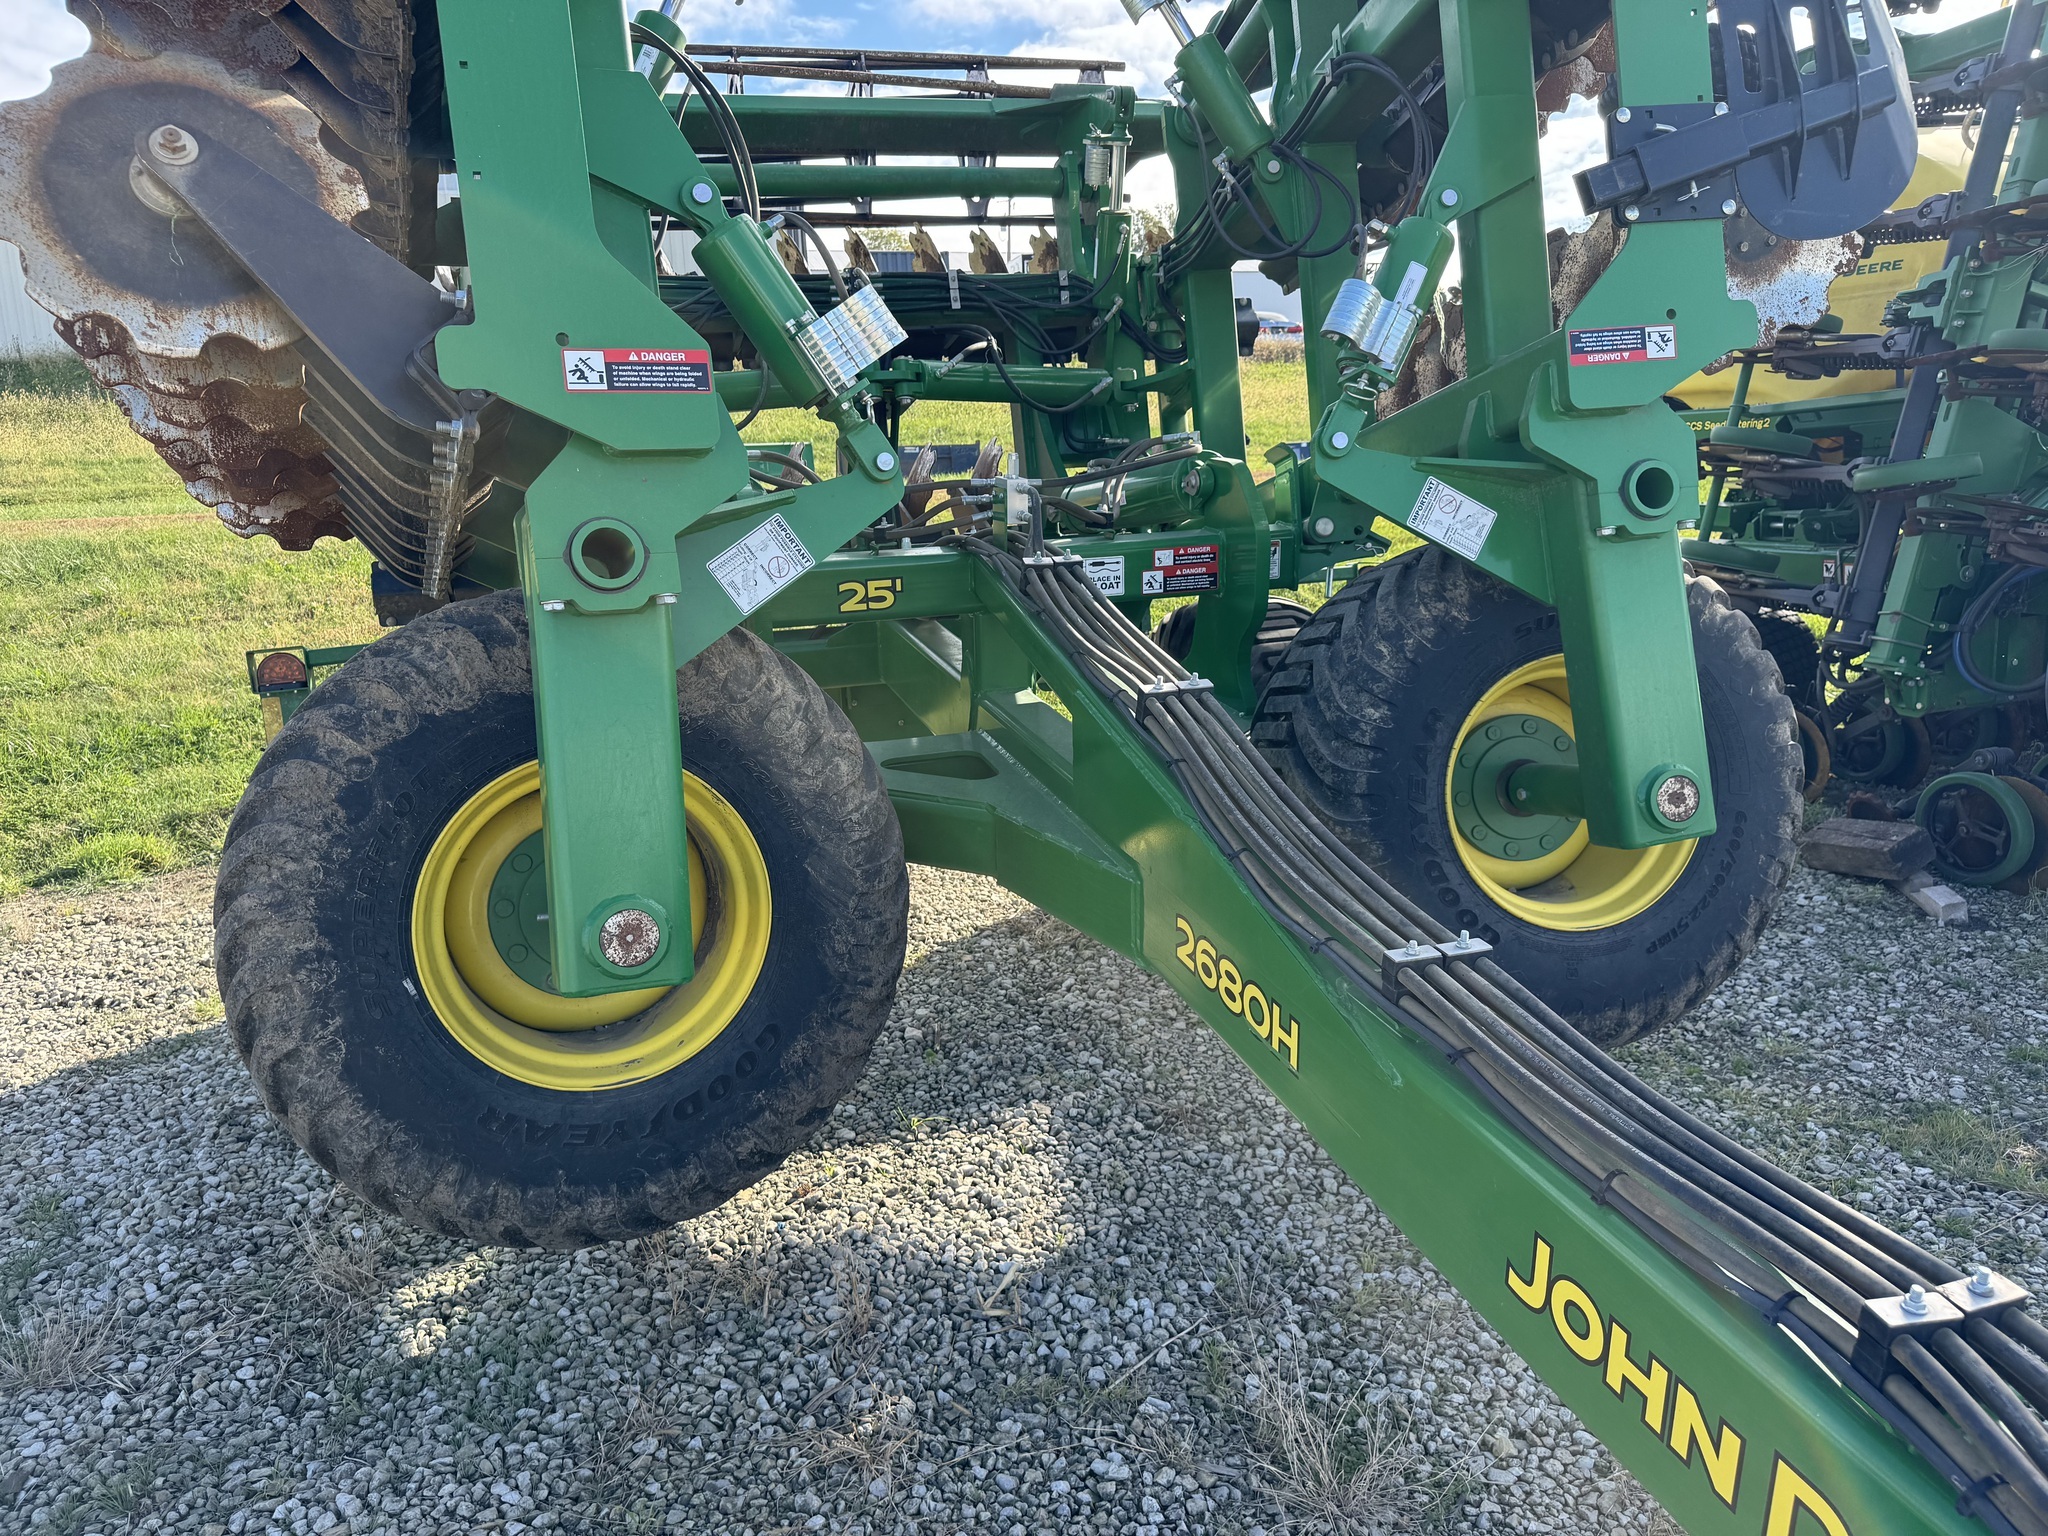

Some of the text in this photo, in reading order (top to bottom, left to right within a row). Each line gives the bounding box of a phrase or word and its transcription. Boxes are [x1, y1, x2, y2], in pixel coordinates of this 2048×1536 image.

[1843, 259, 1904, 277] EERE
[641, 352, 686, 362] DANGER
[1587, 353, 1621, 362] DANGER
[1409, 479, 1436, 524] IMPORTANT
[772, 517, 811, 565] IMPORTANT
[837, 577, 903, 612] 25'
[1408, 706, 1501, 944] GOODYEAR
[1176, 914, 1299, 1074] 2680H
[477, 1022, 783, 1148] GOODYEAR
[1505, 1231, 1746, 1514] JOHN
